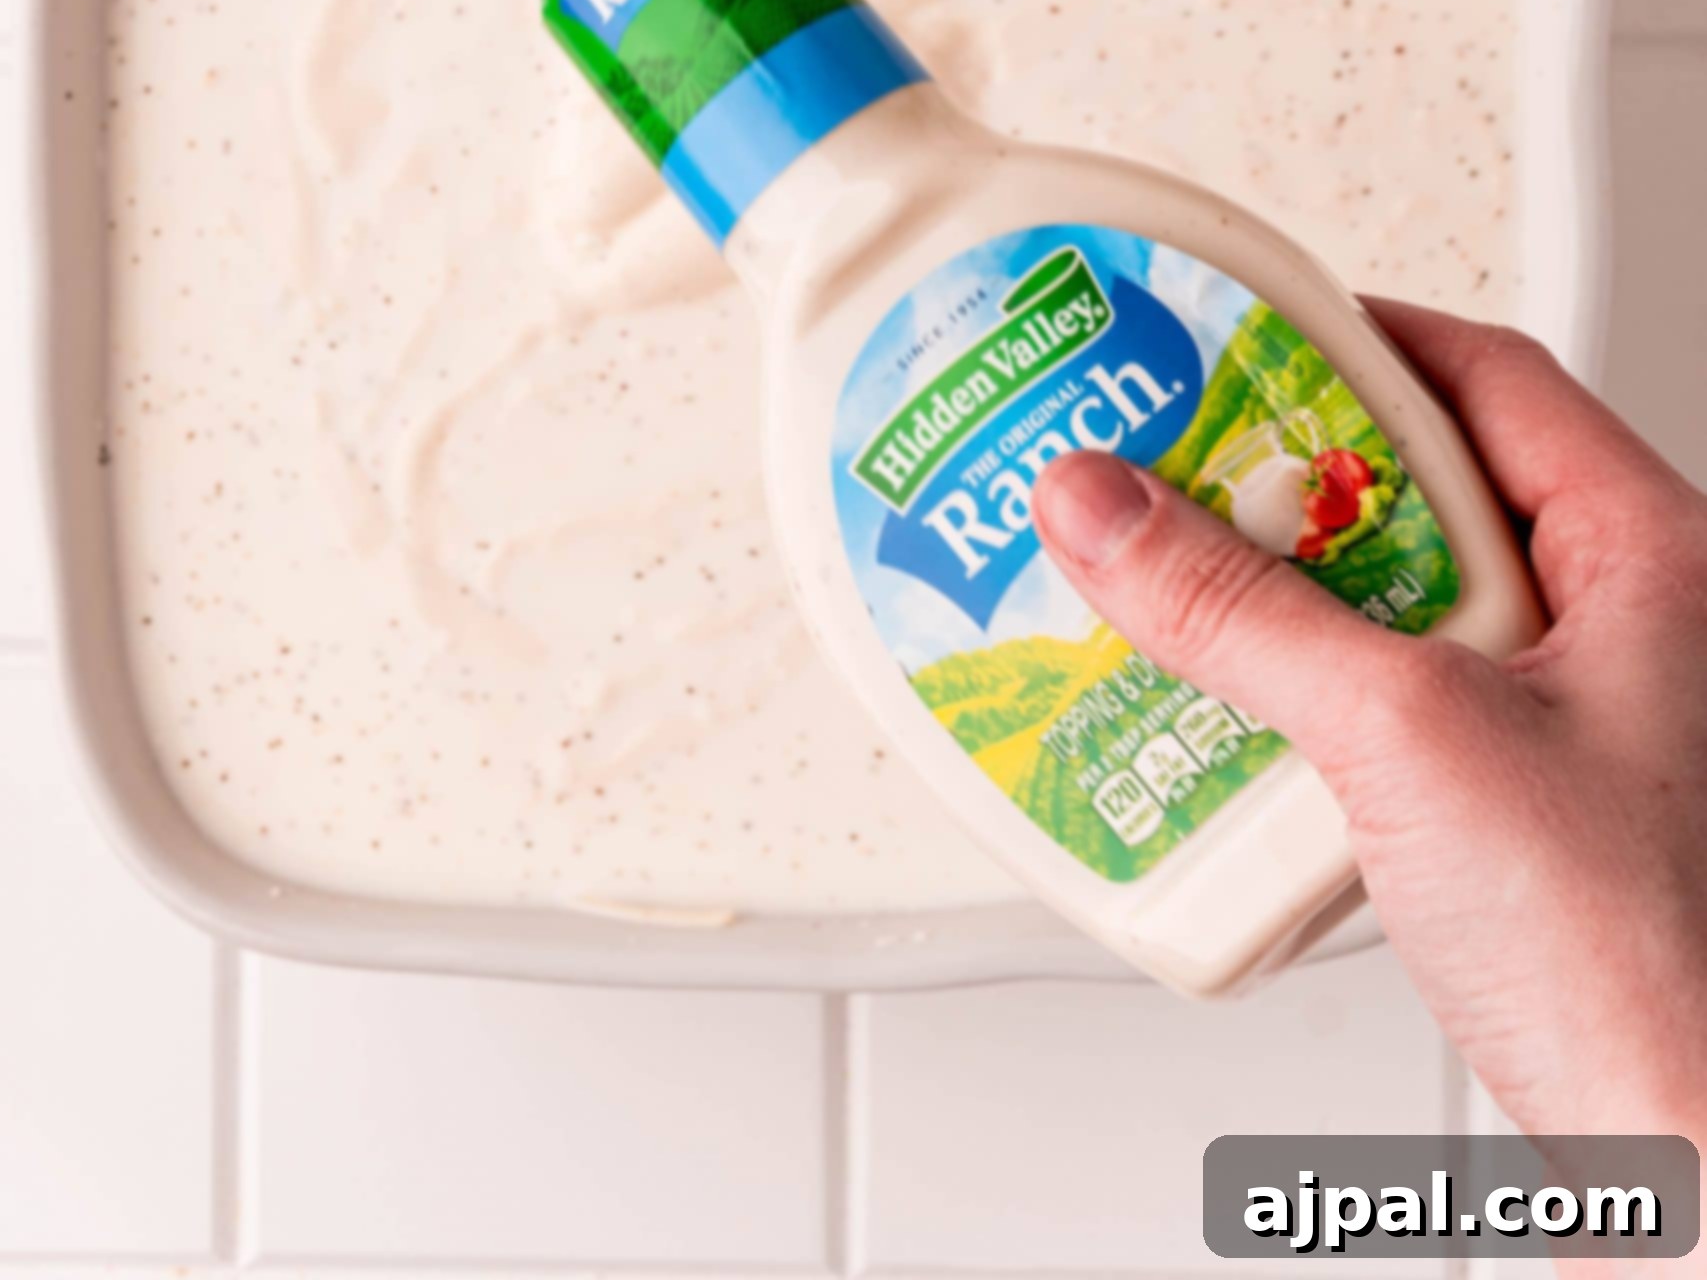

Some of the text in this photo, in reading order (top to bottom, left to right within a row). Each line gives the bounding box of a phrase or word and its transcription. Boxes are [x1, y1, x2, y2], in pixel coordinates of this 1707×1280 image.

[896, 325, 944, 371] SINCE
[871, 372, 999, 492] Hidden
[960, 379, 1085, 489] THE ORIGINAL
[1041, 680, 1124, 762] TOPPING
[1112, 668, 1141, 701] &
[1101, 776, 1142, 818] 120
